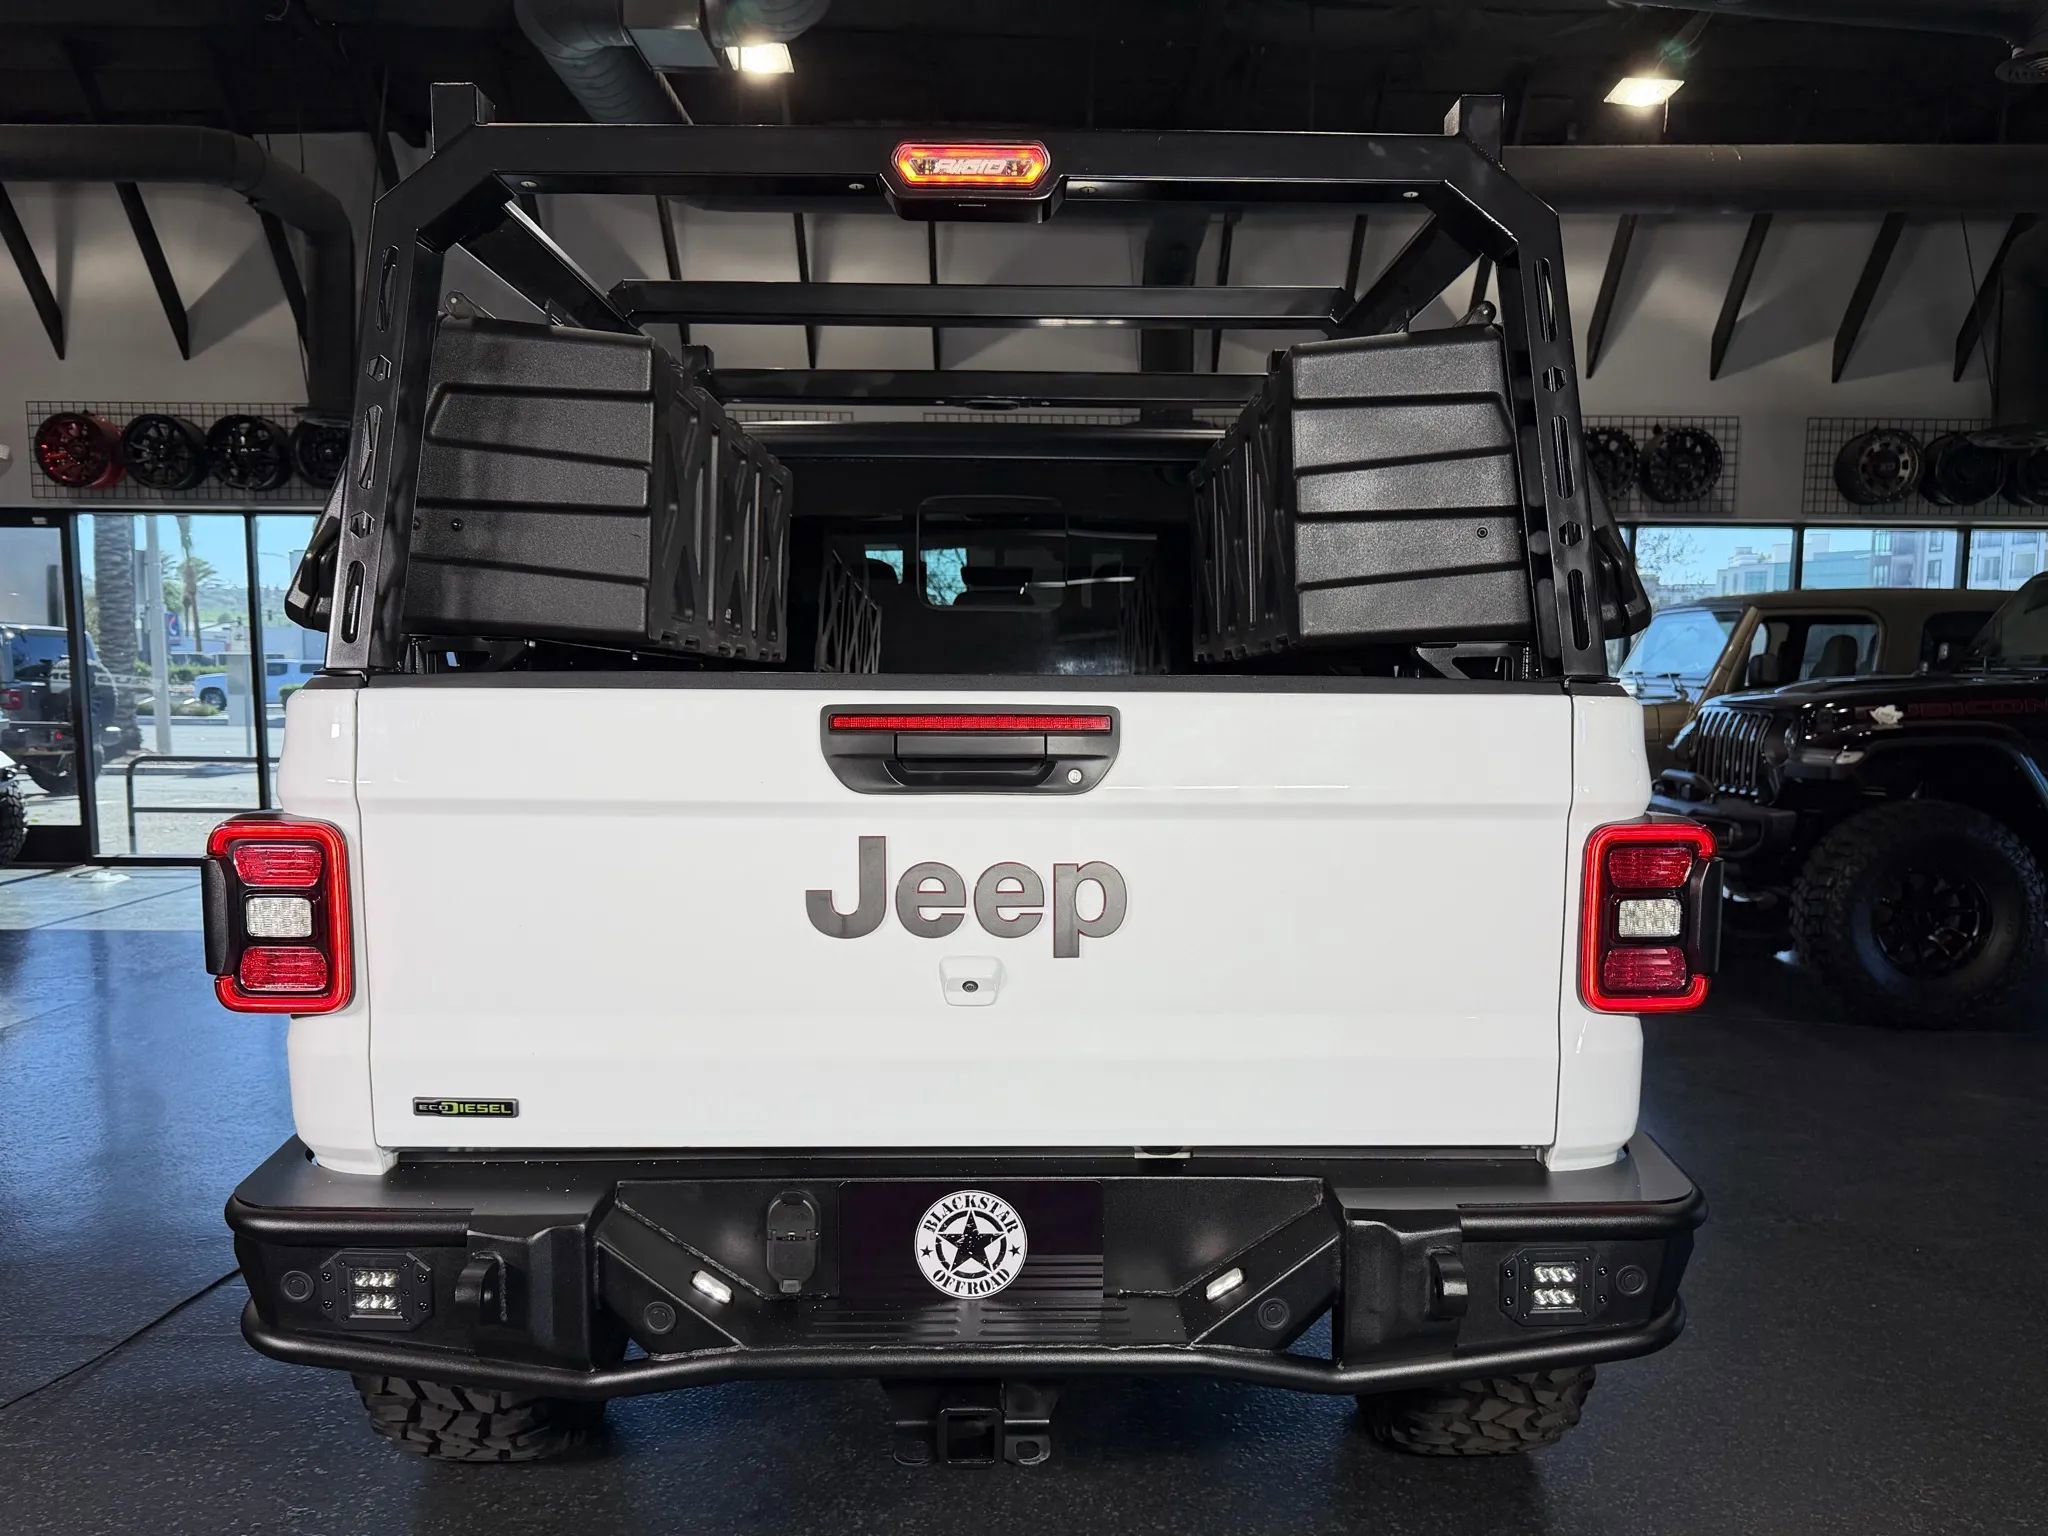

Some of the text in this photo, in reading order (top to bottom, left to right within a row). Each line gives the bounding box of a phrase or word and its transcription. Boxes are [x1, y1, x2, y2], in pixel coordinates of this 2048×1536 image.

[805, 835, 1128, 958] Jeep
[418, 1101, 512, 1114] ECODIESEL
[923, 1195, 1019, 1234] BLACKSTAR
[933, 1268, 1010, 1295] OFFROAD
